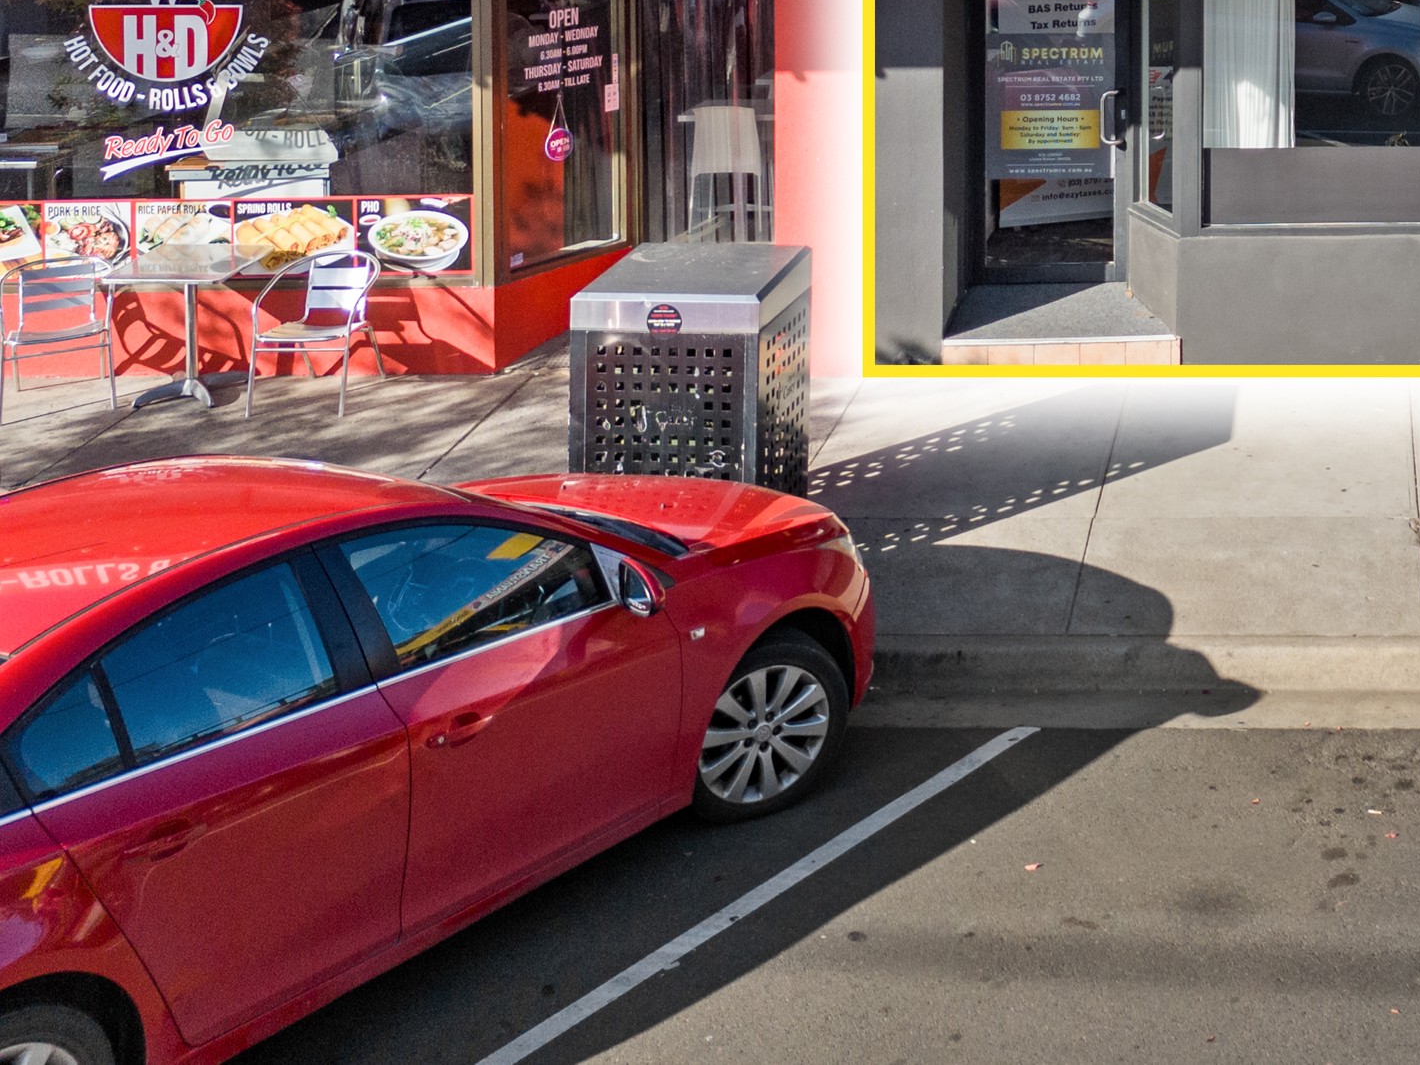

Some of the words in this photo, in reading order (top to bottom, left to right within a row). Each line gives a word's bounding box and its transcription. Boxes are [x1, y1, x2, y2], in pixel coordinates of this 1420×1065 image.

[1028, 4, 1051, 14] BAS
[549, 7, 579, 29] OPEN
[1030, 21, 1049, 30] Tax
[528, 32, 559, 47] MONDAY
[123, 14, 208, 79] H&D
[1022, 47, 1104, 59] SPECTRUM
[63, 35, 99, 71] HOT
[87, 65, 136, 103] FOOD
[149, 84, 207, 111] ROLLS
[225, 33, 269, 91] BOWLS
[524, 63, 562, 80] THURSDAY
[568, 55, 603, 72] SATURDAY
[564, 76, 576, 87] TILL
[577, 74, 590, 85] LATE
[1023, 116, 1055, 124] Opening
[105, 126, 173, 160] Ready
[174, 124, 200, 147] To
[204, 118, 235, 144] Go
[550, 136, 570, 148] OPEN
[48, 206, 71, 217] PORK
[82, 206, 101, 216] RICE
[138, 205, 155, 215] RICE
[157, 205, 181, 214] PAPER
[184, 204, 207, 215] ROLLS
[237, 203, 265, 214] SPRING
[267, 202, 292, 214] ROLLS
[361, 201, 379, 213] PHO
